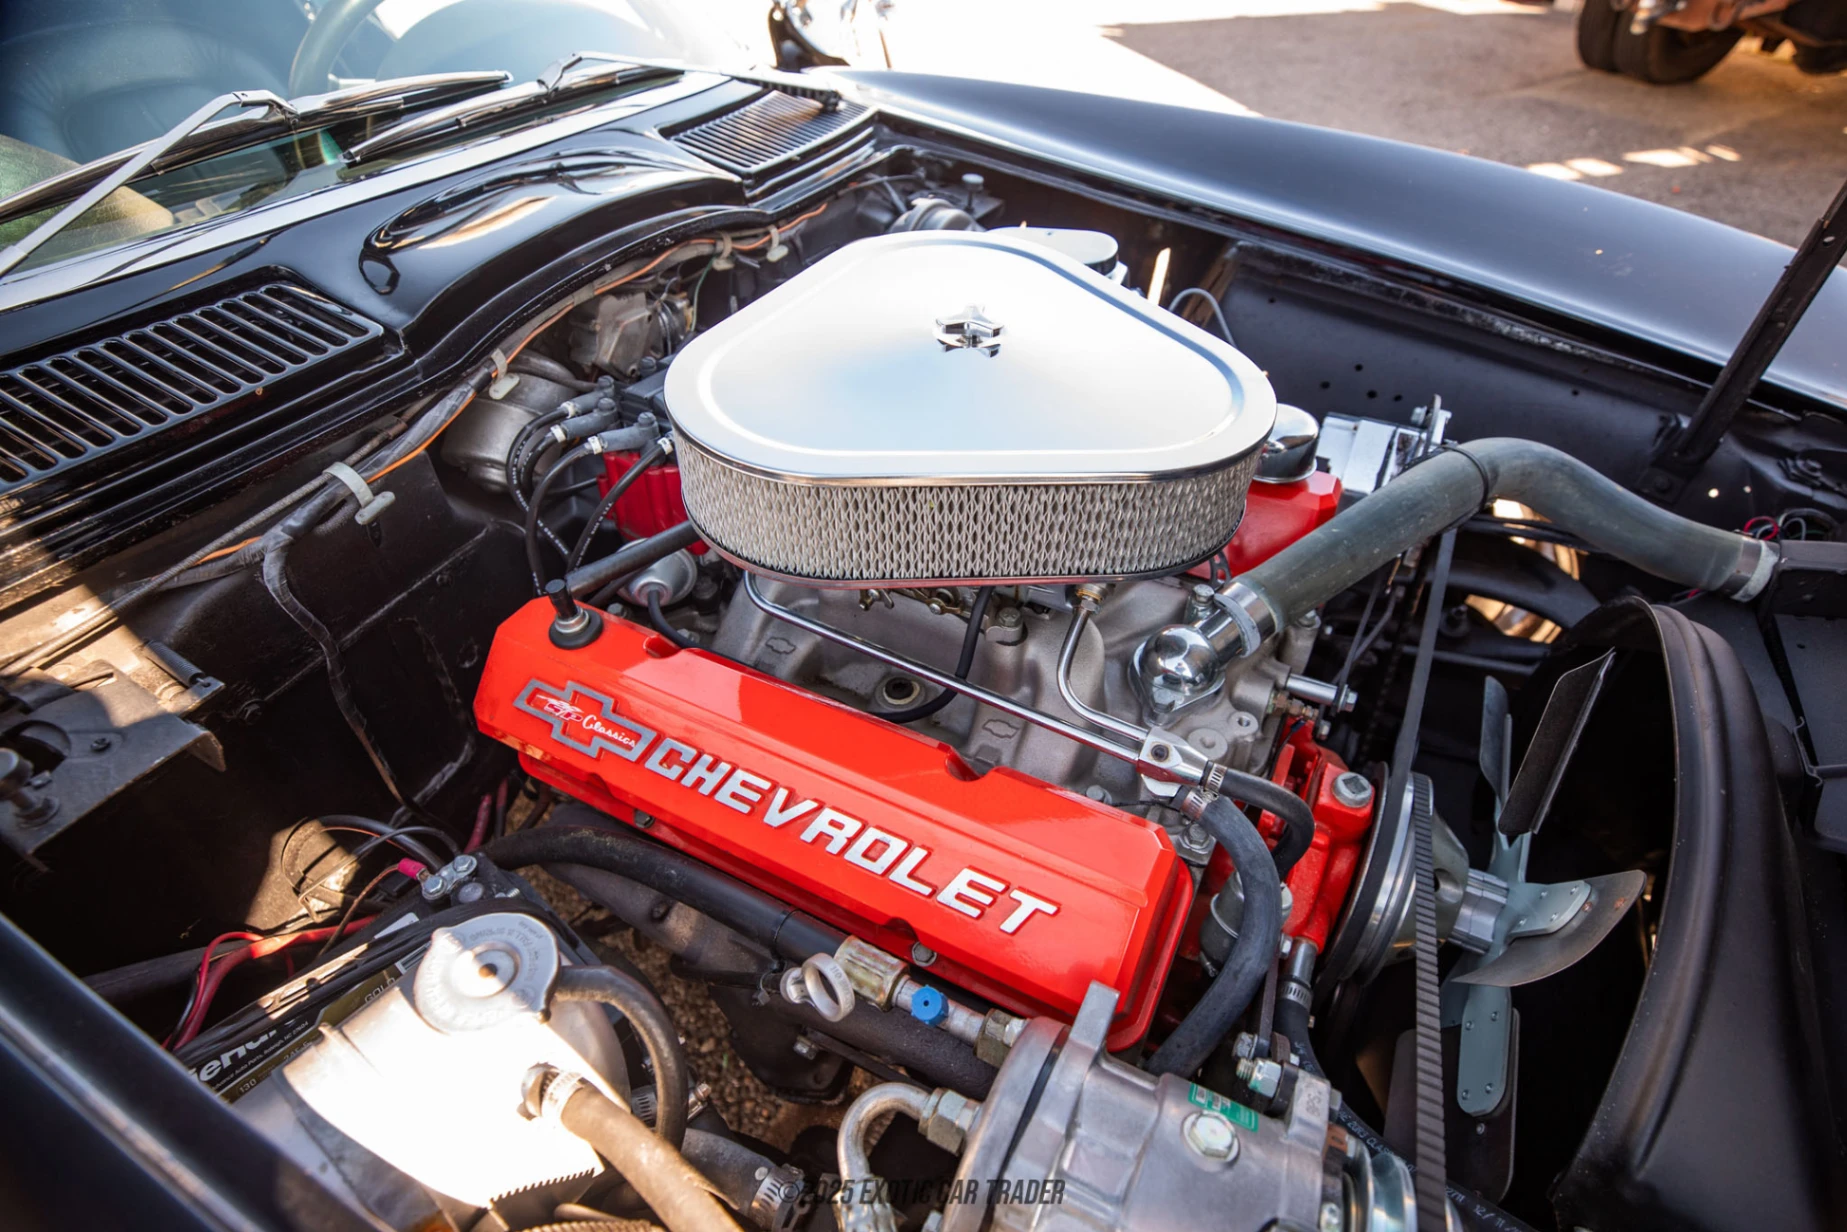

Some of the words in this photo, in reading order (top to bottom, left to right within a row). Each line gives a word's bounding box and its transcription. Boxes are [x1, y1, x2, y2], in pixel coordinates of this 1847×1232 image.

[582, 715, 635, 748] Classics
[645, 737, 1059, 935] CHEVROLET
[239, 1079, 257, 1093] 130
